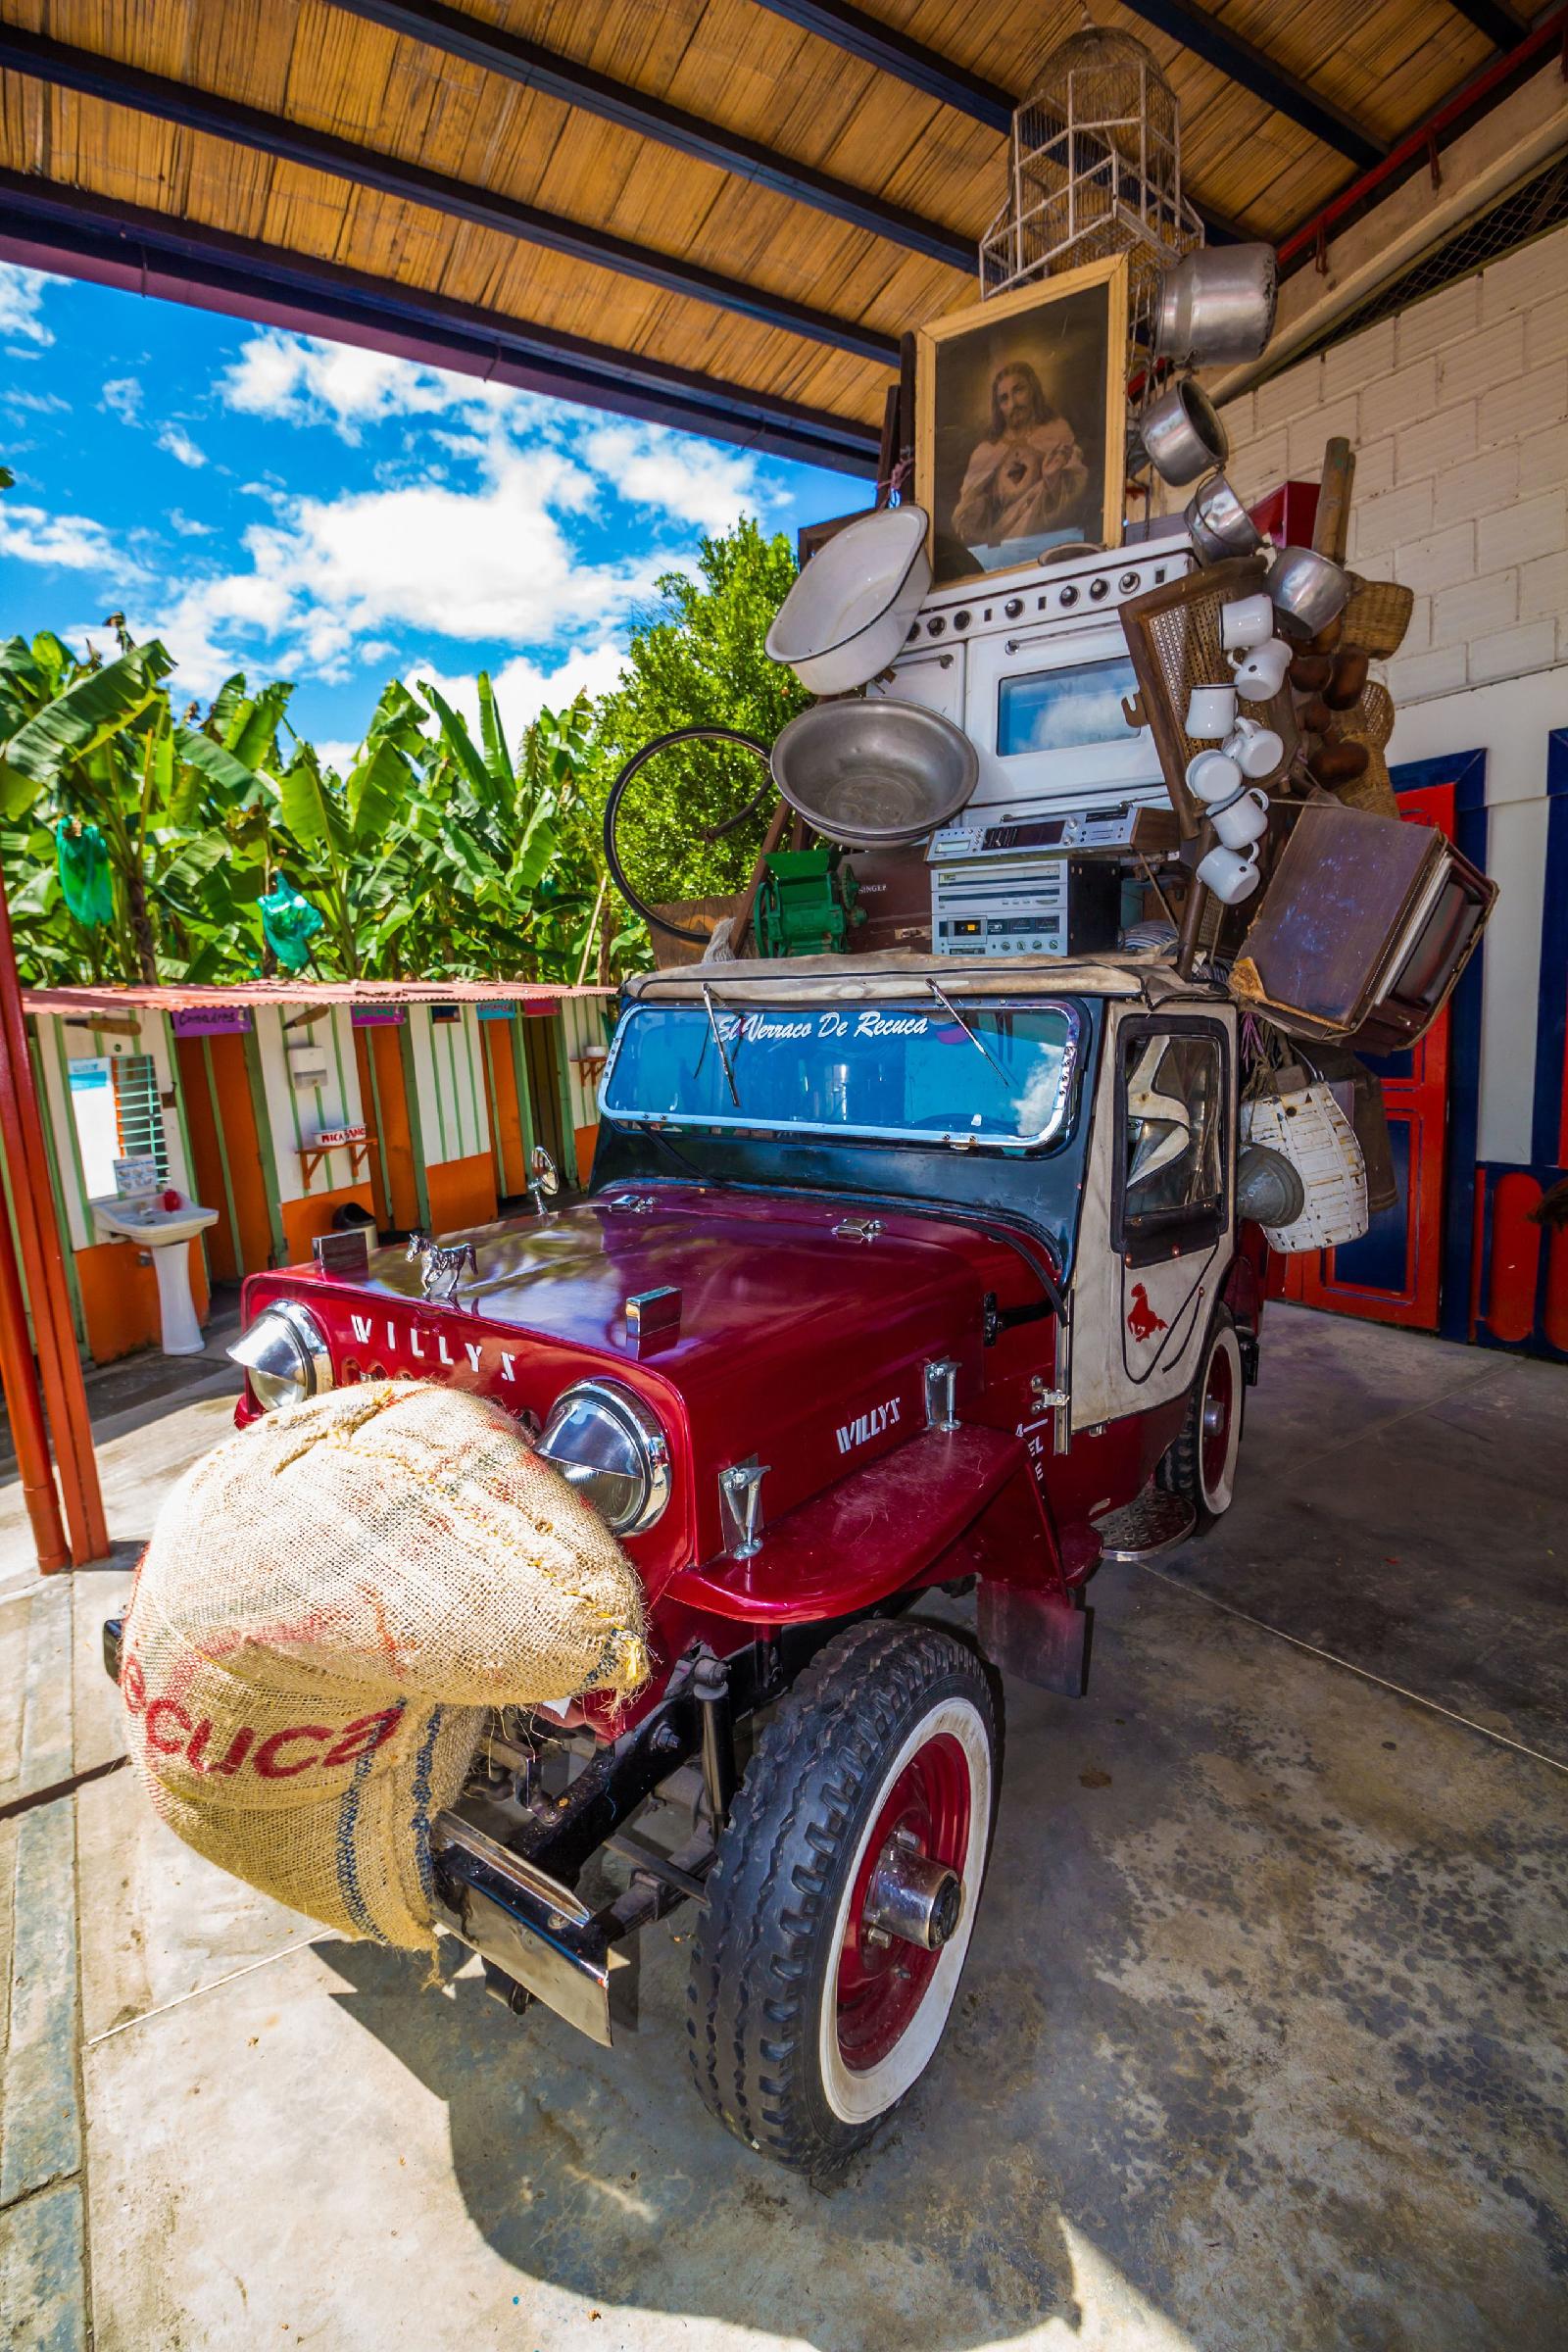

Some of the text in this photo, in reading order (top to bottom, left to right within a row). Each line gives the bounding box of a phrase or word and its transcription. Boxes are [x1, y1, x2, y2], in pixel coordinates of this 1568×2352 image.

[714, 1010, 928, 1045] El Verraco De Recuca
[351, 1314, 516, 1382] WILLYS
[835, 1396, 901, 1454] WILLYS
